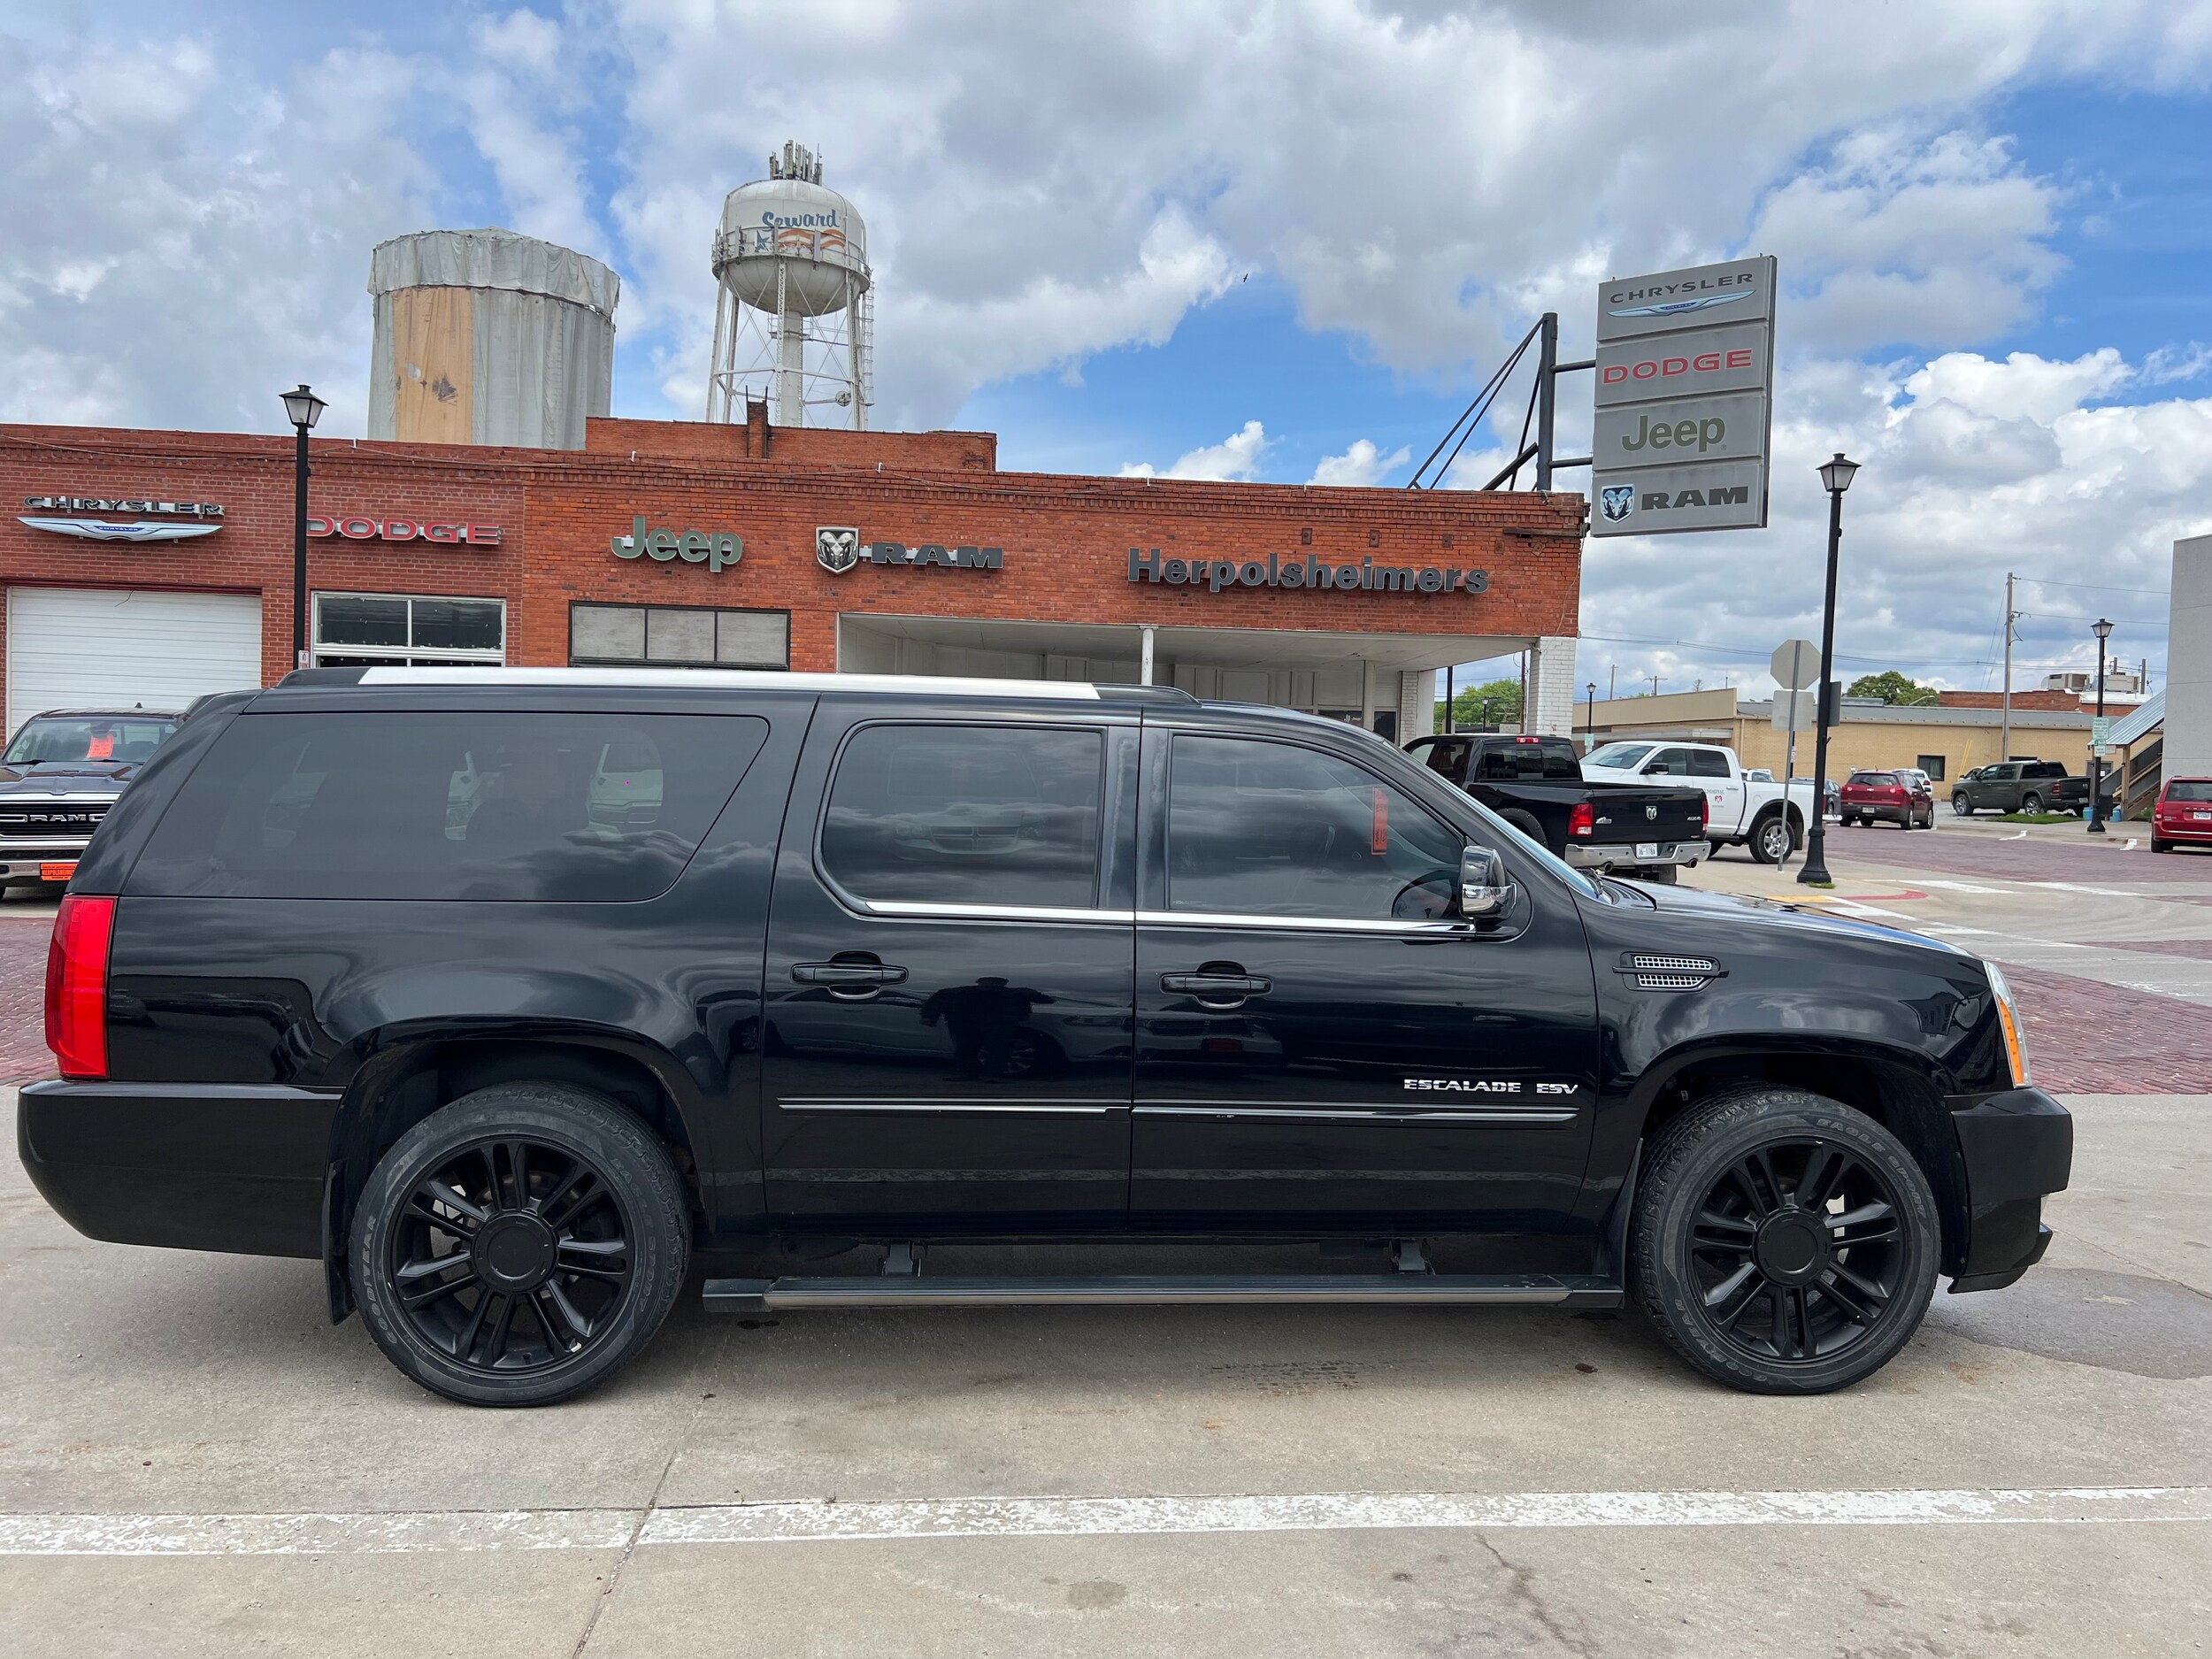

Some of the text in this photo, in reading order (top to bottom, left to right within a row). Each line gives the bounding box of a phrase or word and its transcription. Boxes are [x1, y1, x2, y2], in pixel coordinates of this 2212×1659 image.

[762, 209, 841, 229] Seward
[1609, 273, 1754, 303] CHRYSLER
[1602, 349, 1753, 385] DODGE
[1621, 415, 1725, 452] Jeep
[24, 495, 224, 516] CHRYSLER
[1641, 486, 1748, 511] RAM
[306, 515, 502, 545] DODGE
[611, 515, 743, 572] Jeep
[871, 541, 1004, 569] RAM
[1127, 546, 1490, 595] Herpolsheimers
[1404, 1079, 1578, 1094] ESCALADE ESV
[1816, 1118, 1927, 1218] EAGLE SPORT
[362, 1215, 397, 1344] GOODYEAR
[1675, 1299, 1767, 1381] GOODYEAR
